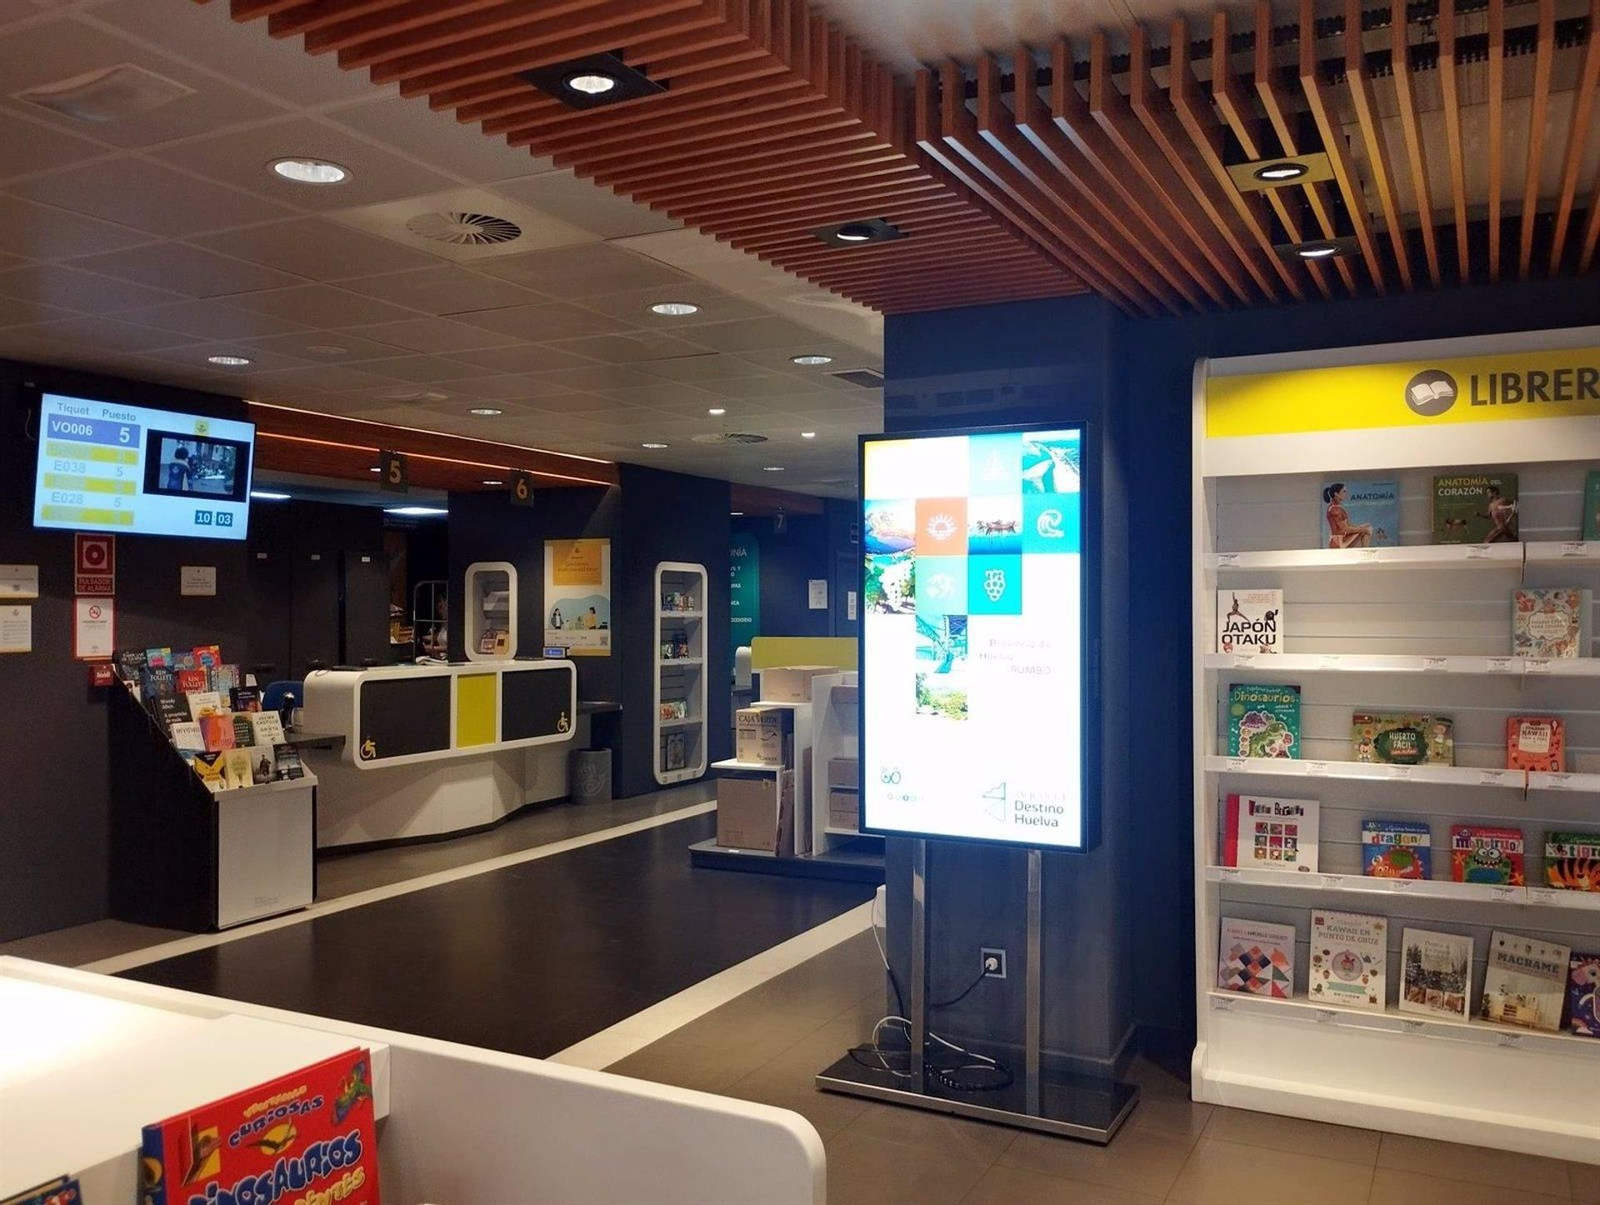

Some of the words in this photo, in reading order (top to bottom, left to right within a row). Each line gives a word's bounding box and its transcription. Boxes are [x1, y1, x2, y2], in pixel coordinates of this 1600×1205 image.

[57, 402, 89, 415] Tiquet
[102, 408, 136, 421] Puesto
[119, 426, 130, 443] 5
[388, 459, 401, 484] 5
[1438, 476, 1489, 487] ANATOMÍA
[516, 478, 528, 499] 6
[1438, 486, 1483, 496] CORAZÓN
[1222, 618, 1276, 633] JAPÓN
[1221, 634, 1276, 645] OTAKU
[1234, 690, 1296, 703] Dinosaurios
[738, 713, 755, 723] CAJA
[1388, 732, 1416, 740] HUERTO
[1014, 800, 1064, 814] Destino
[1014, 813, 1059, 827] Huelva
[1326, 925, 1358, 935] KAWAII
